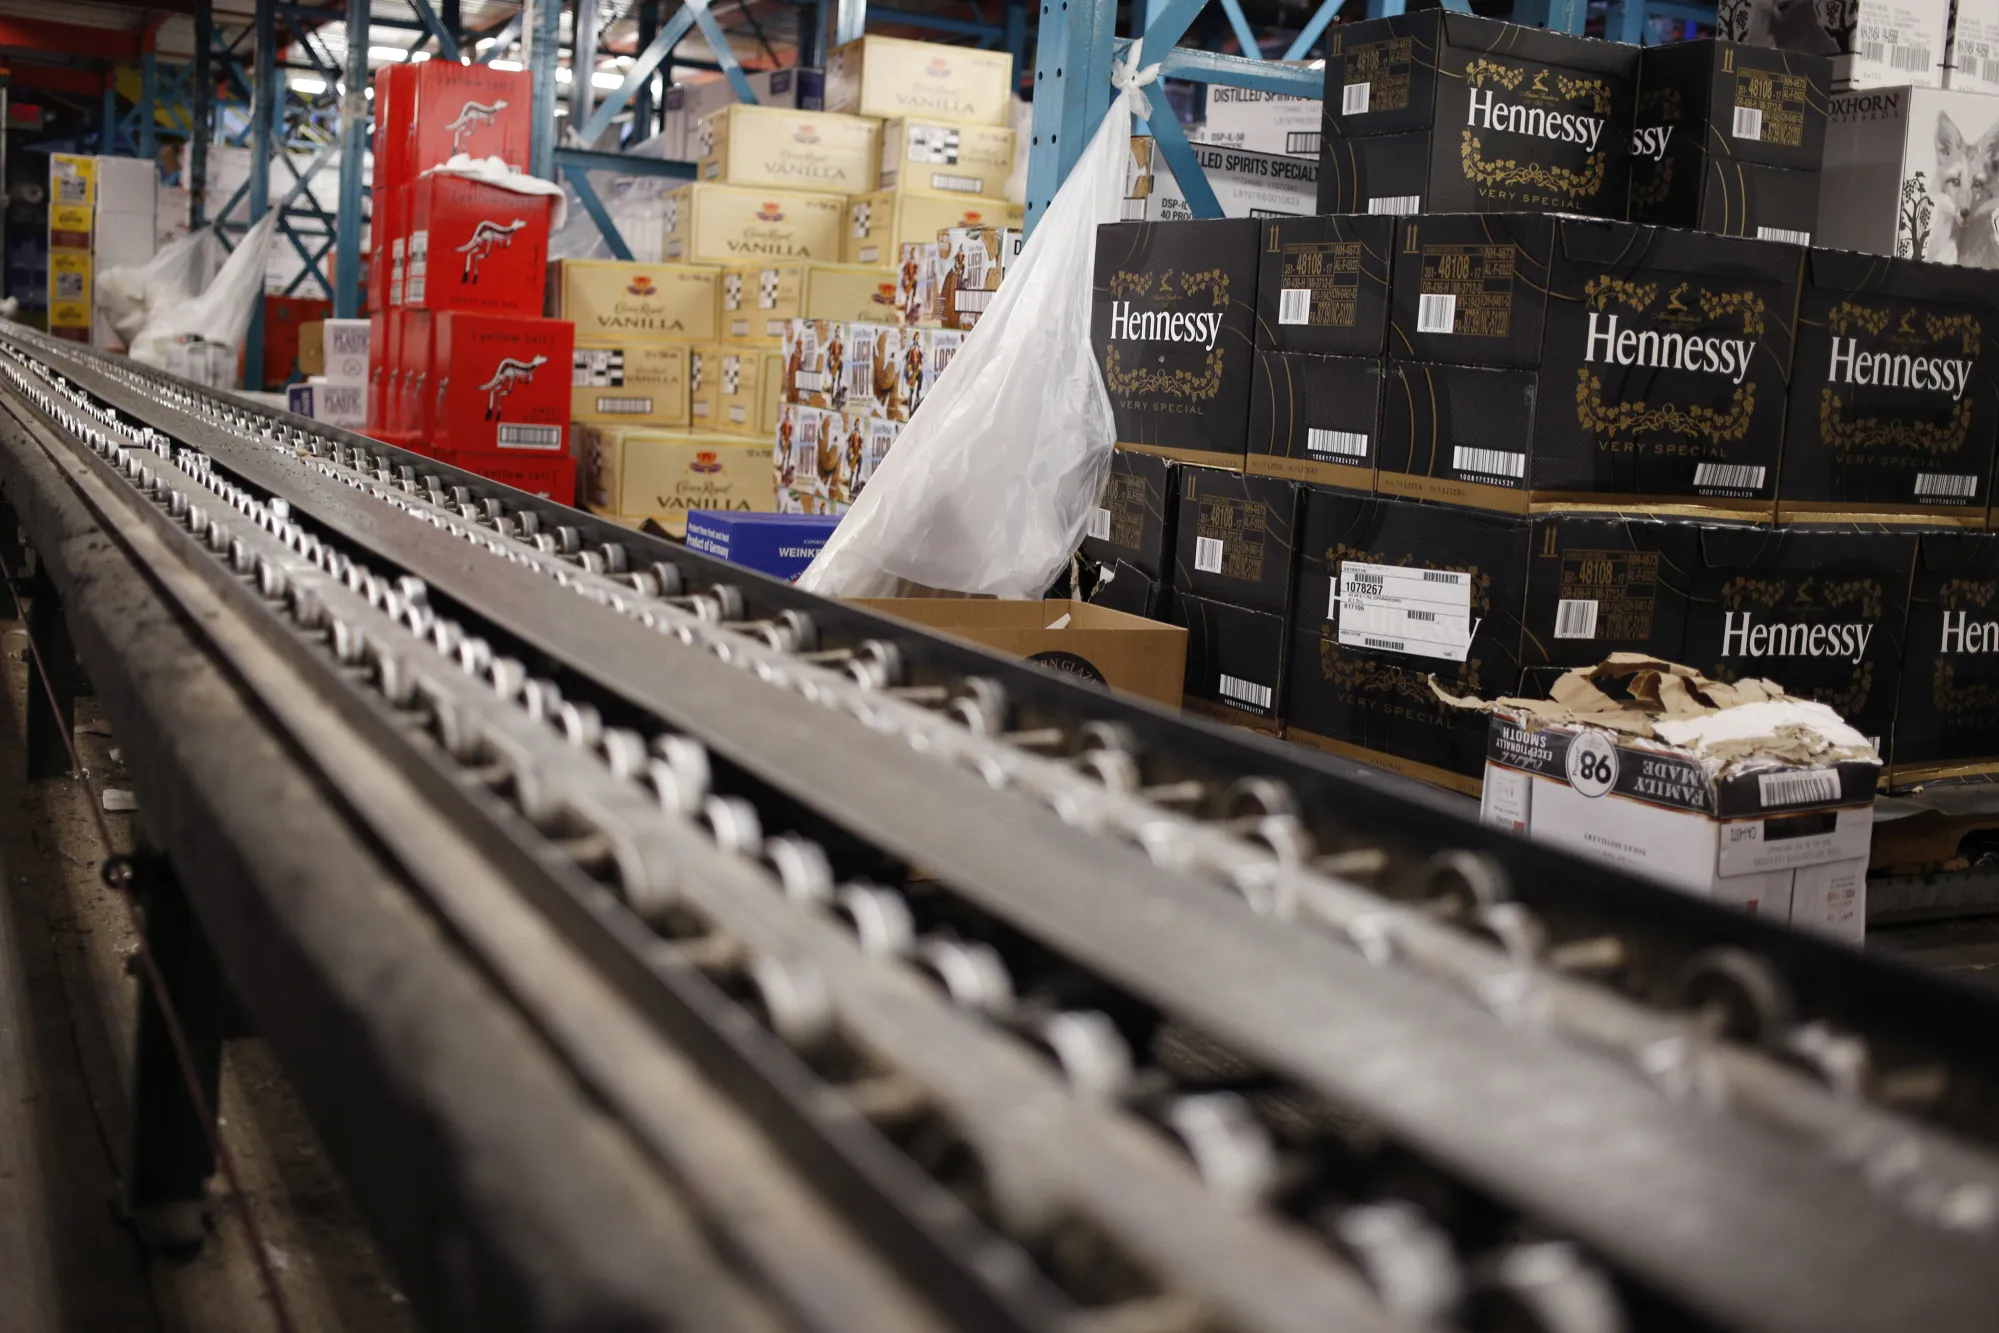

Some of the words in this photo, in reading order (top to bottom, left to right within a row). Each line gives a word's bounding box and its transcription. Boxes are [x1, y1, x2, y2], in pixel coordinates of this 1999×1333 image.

[1213, 88, 1262, 102] DISTILLED
[1749, 78, 1773, 100] 48108
[896, 94, 976, 114] VANILLA
[1467, 87, 1605, 153] Hennessy
[764, 162, 847, 180] VANILLA
[1225, 155, 1268, 176] SPIRITS
[1479, 187, 1516, 200] VERY
[1522, 194, 1583, 210] SPECIAL
[1160, 210, 1171, 220] 40
[727, 241, 811, 258] VANILLA
[1297, 253, 1323, 275] 48108
[1438, 255, 1470, 280] 48108
[967, 267, 982, 288] NUT
[597, 316, 684, 331] VANILLA
[1110, 301, 1223, 351] Hennessy
[852, 341, 871, 362] LOCO
[1584, 312, 1757, 384] Hennessy
[852, 364, 870, 396] NUT
[1828, 336, 1974, 402] Hennessy
[1120, 400, 1147, 412] VERY
[1152, 402, 1204, 415] SPECIAL
[799, 446, 815, 475] NUT
[1598, 440, 1645, 454] VERY
[1654, 443, 1728, 459] SPECIAL
[1460, 474, 1514, 487] 10081753824539
[656, 495, 752, 511] VANILLA
[1210, 505, 1234, 528] 48108
[686, 534, 704, 551] Product
[704, 538, 709, 551] of
[709, 539, 729, 560] Germany
[1579, 560, 1613, 585] 48108
[1345, 581, 1384, 595] 1078267
[1720, 611, 1874, 664] Hennessy
[1502, 726, 1547, 749] SMOOTH
[1496, 737, 1553, 762] EXCEPTIONALLY
[1642, 759, 1701, 787] MADE
[1633, 776, 1705, 807] FAMILY
[1583, 833, 1622, 850] DISTILLERY
